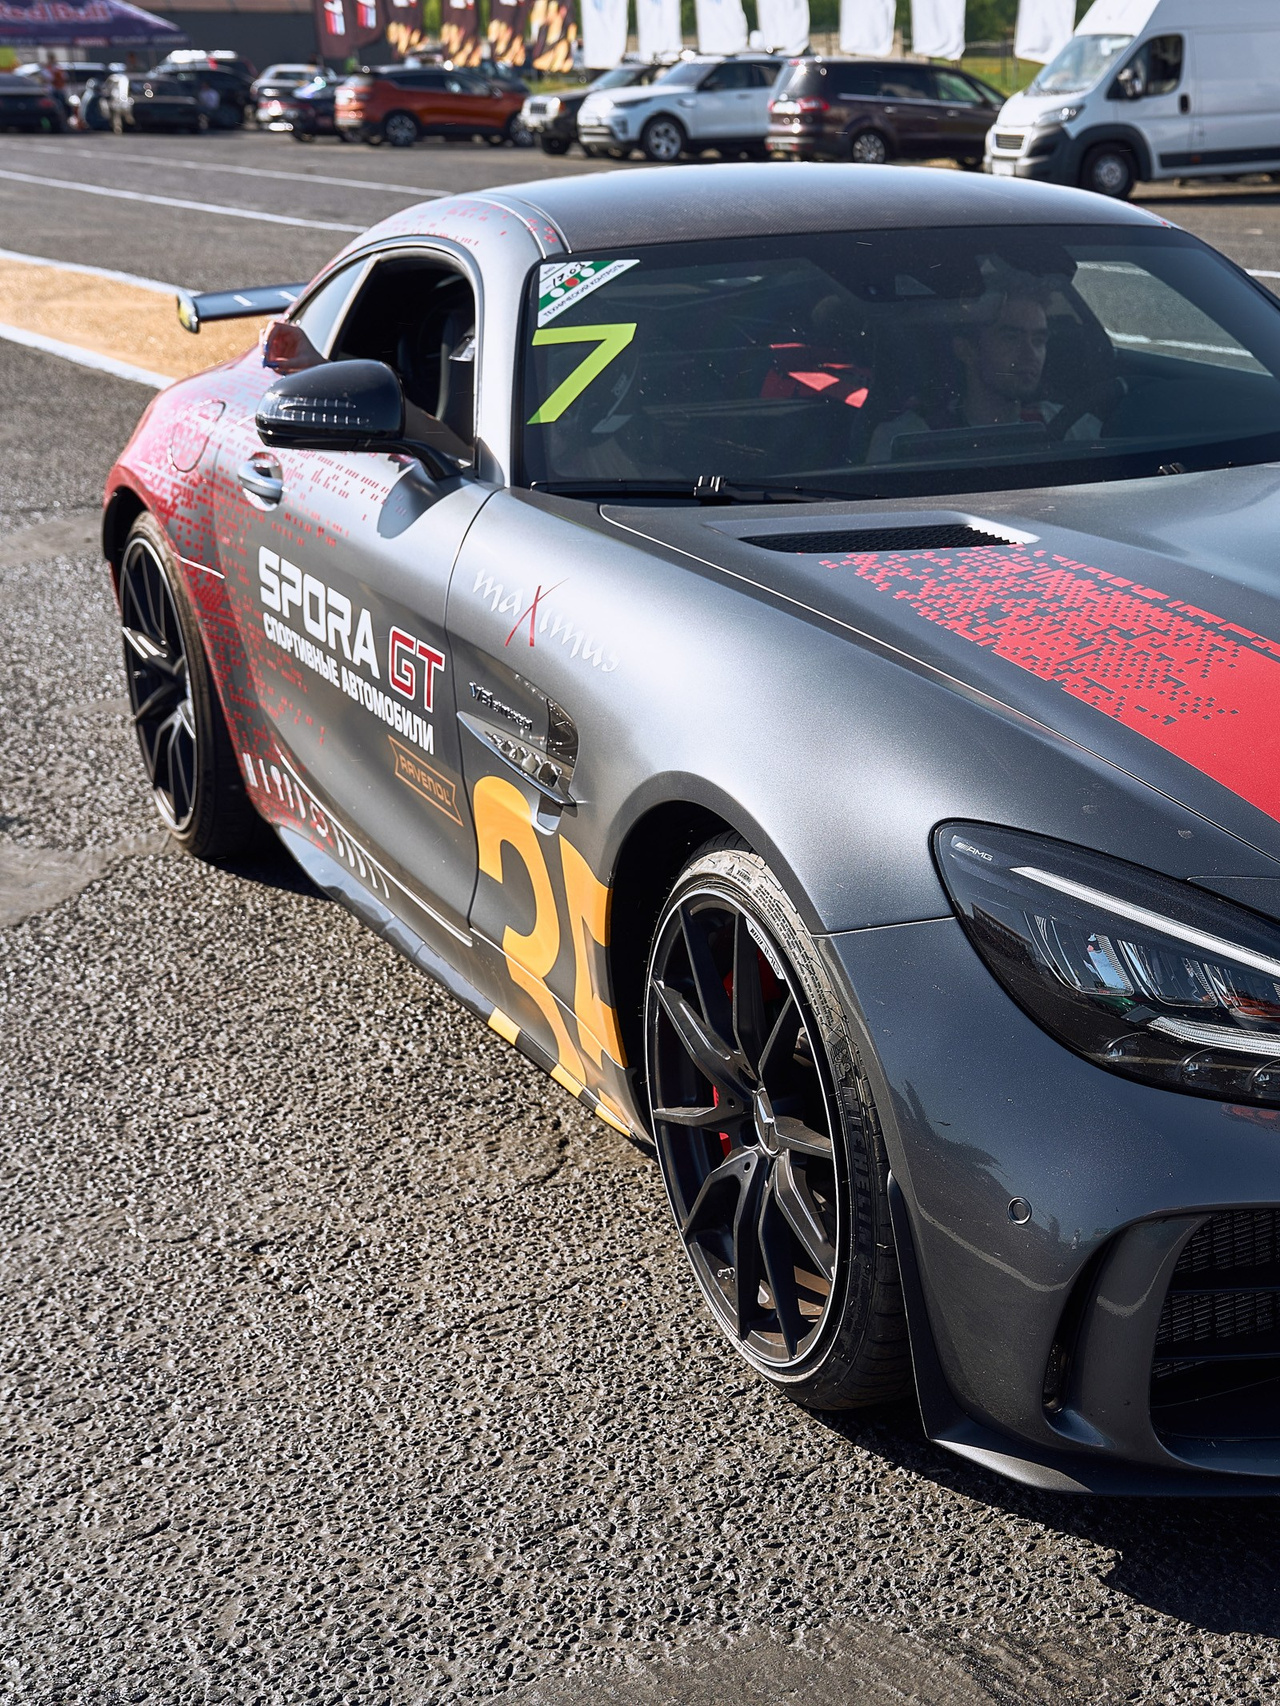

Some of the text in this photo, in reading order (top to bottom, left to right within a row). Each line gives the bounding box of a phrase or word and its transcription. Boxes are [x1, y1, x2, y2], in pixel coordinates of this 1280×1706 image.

[526, 322, 638, 425] 7
[258, 545, 446, 714] SPORA GT
[262, 611, 436, 756] СПОРТИВНЫЕ АВТОМОБИЛИ
[398, 753, 453, 807] RAVENOL
[963, 844, 994, 862] AMG
[841, 1086, 875, 1249] MICHELIN
